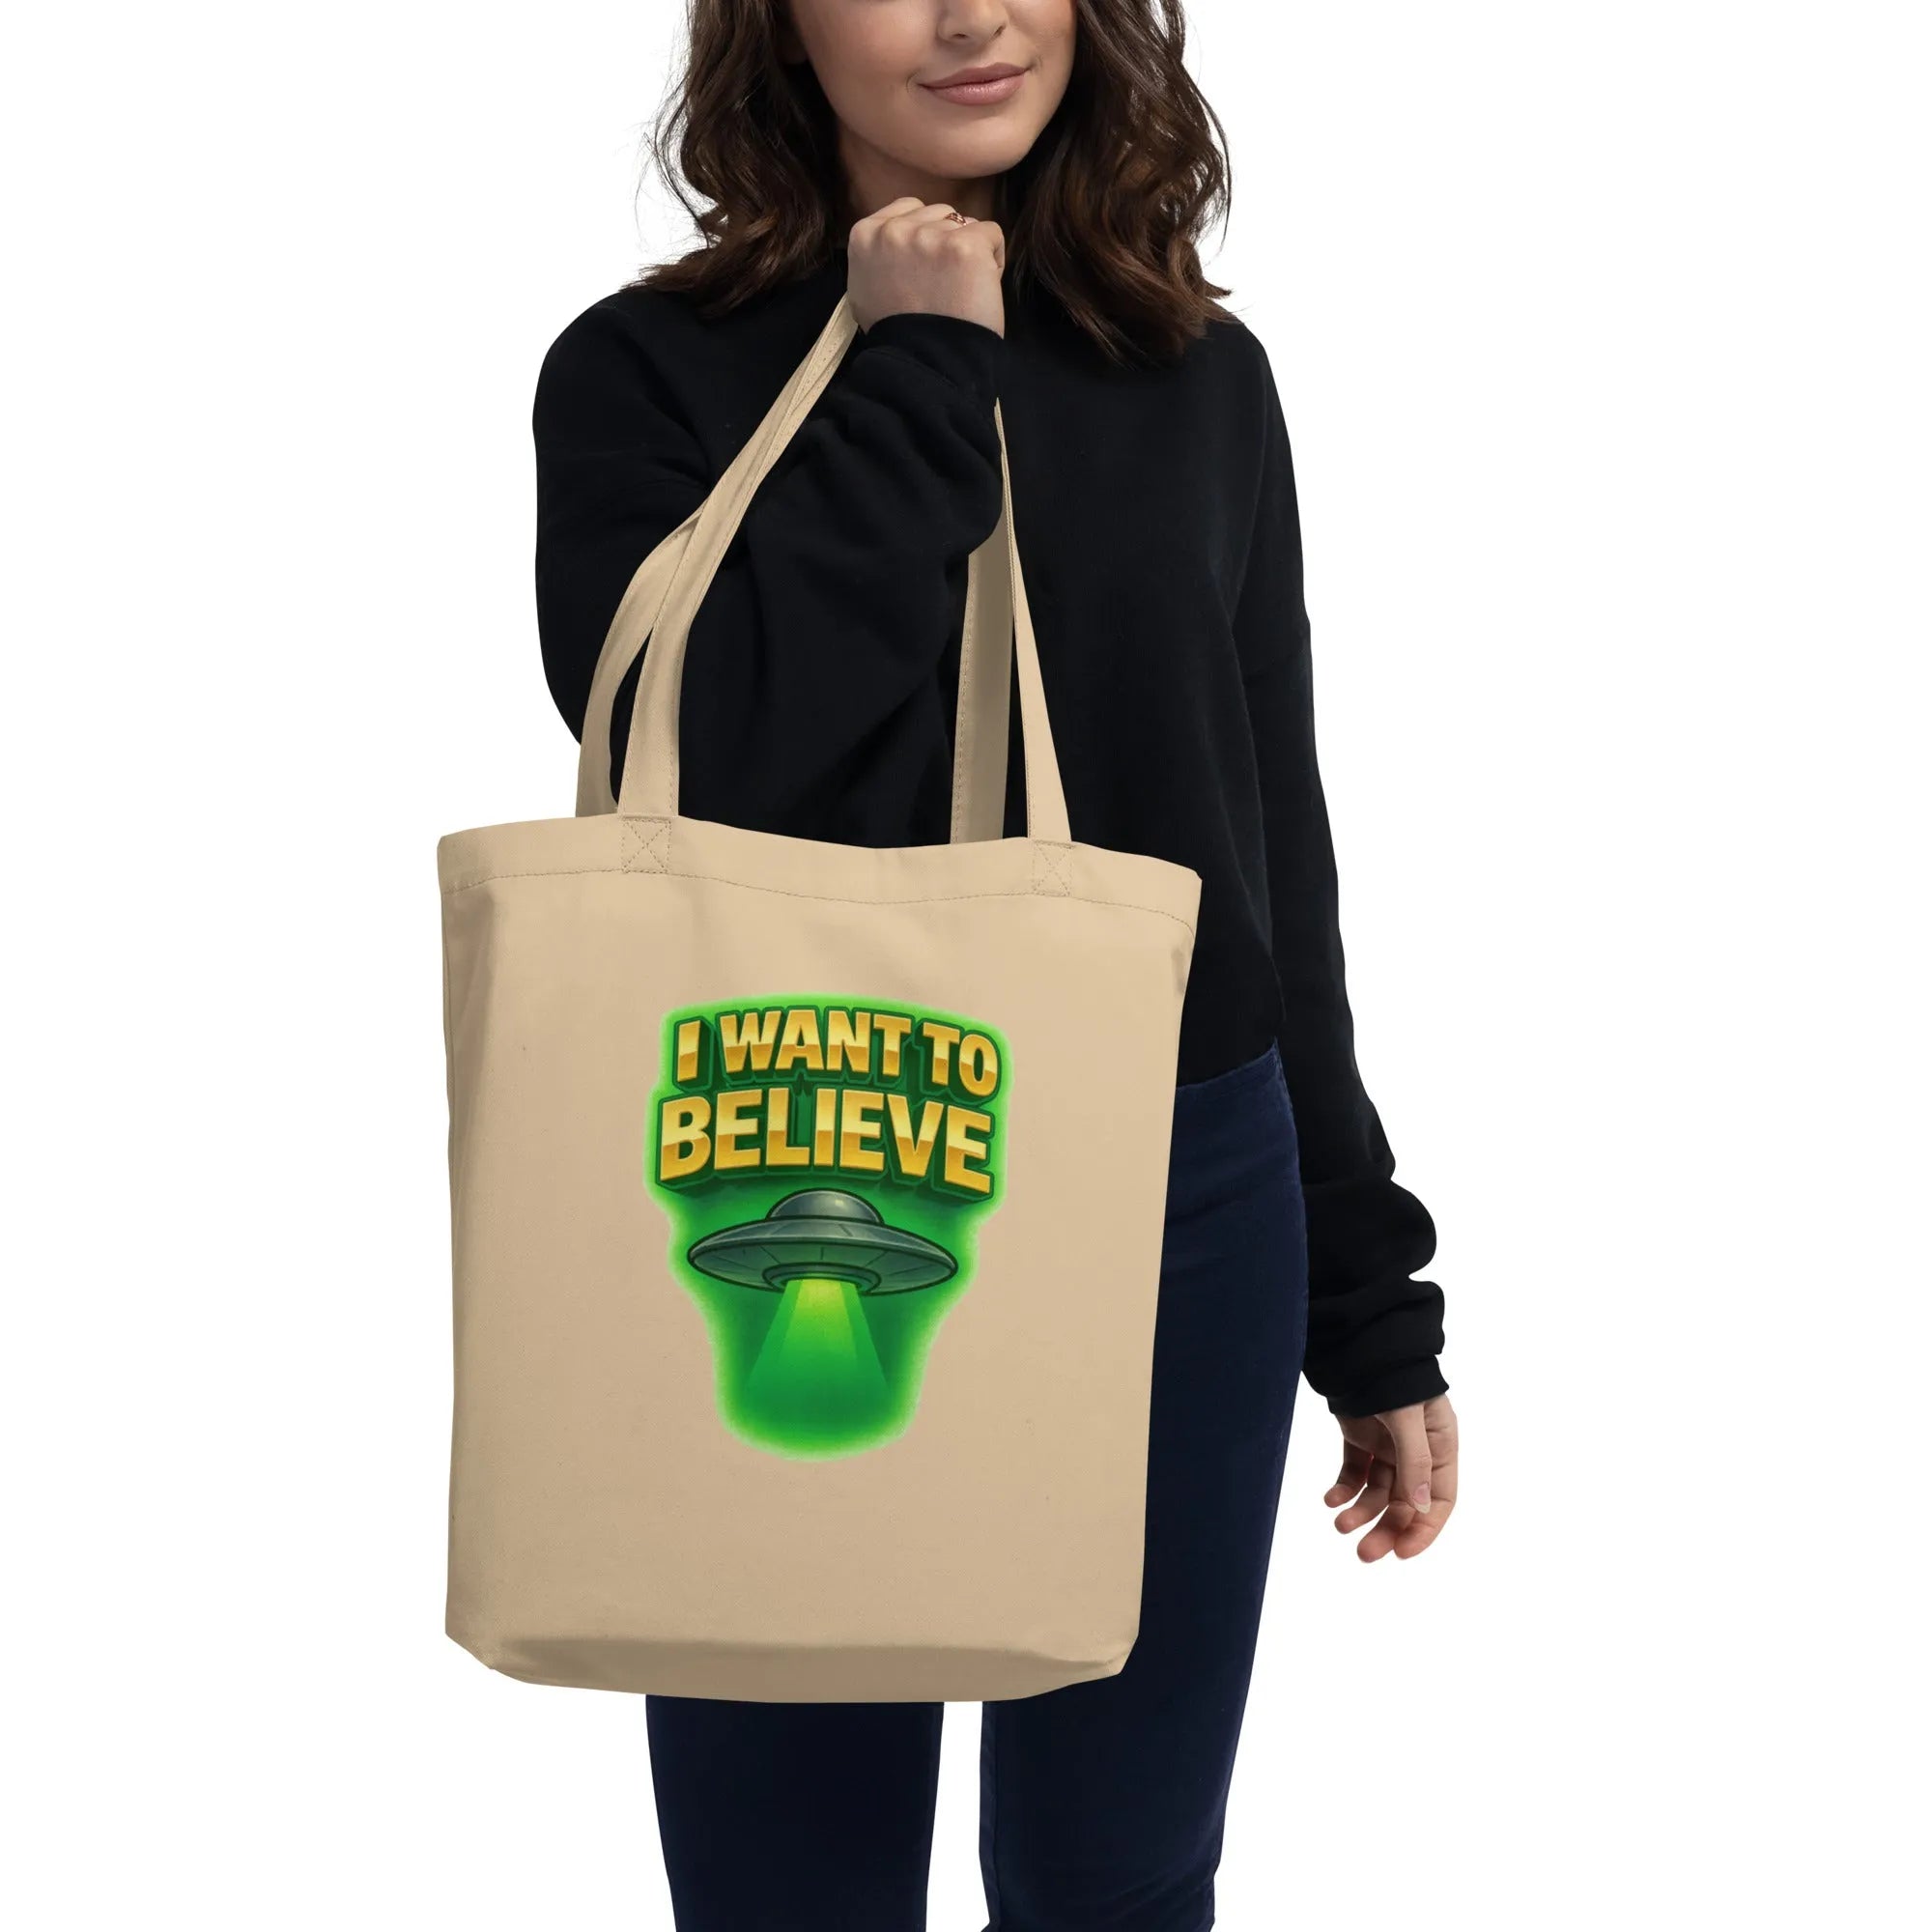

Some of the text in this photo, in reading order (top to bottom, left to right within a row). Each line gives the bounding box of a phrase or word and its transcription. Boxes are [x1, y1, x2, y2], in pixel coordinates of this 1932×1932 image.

[676, 1009, 999, 1096] I WANT TO
[660, 1087, 991, 1194] BELIEVE
